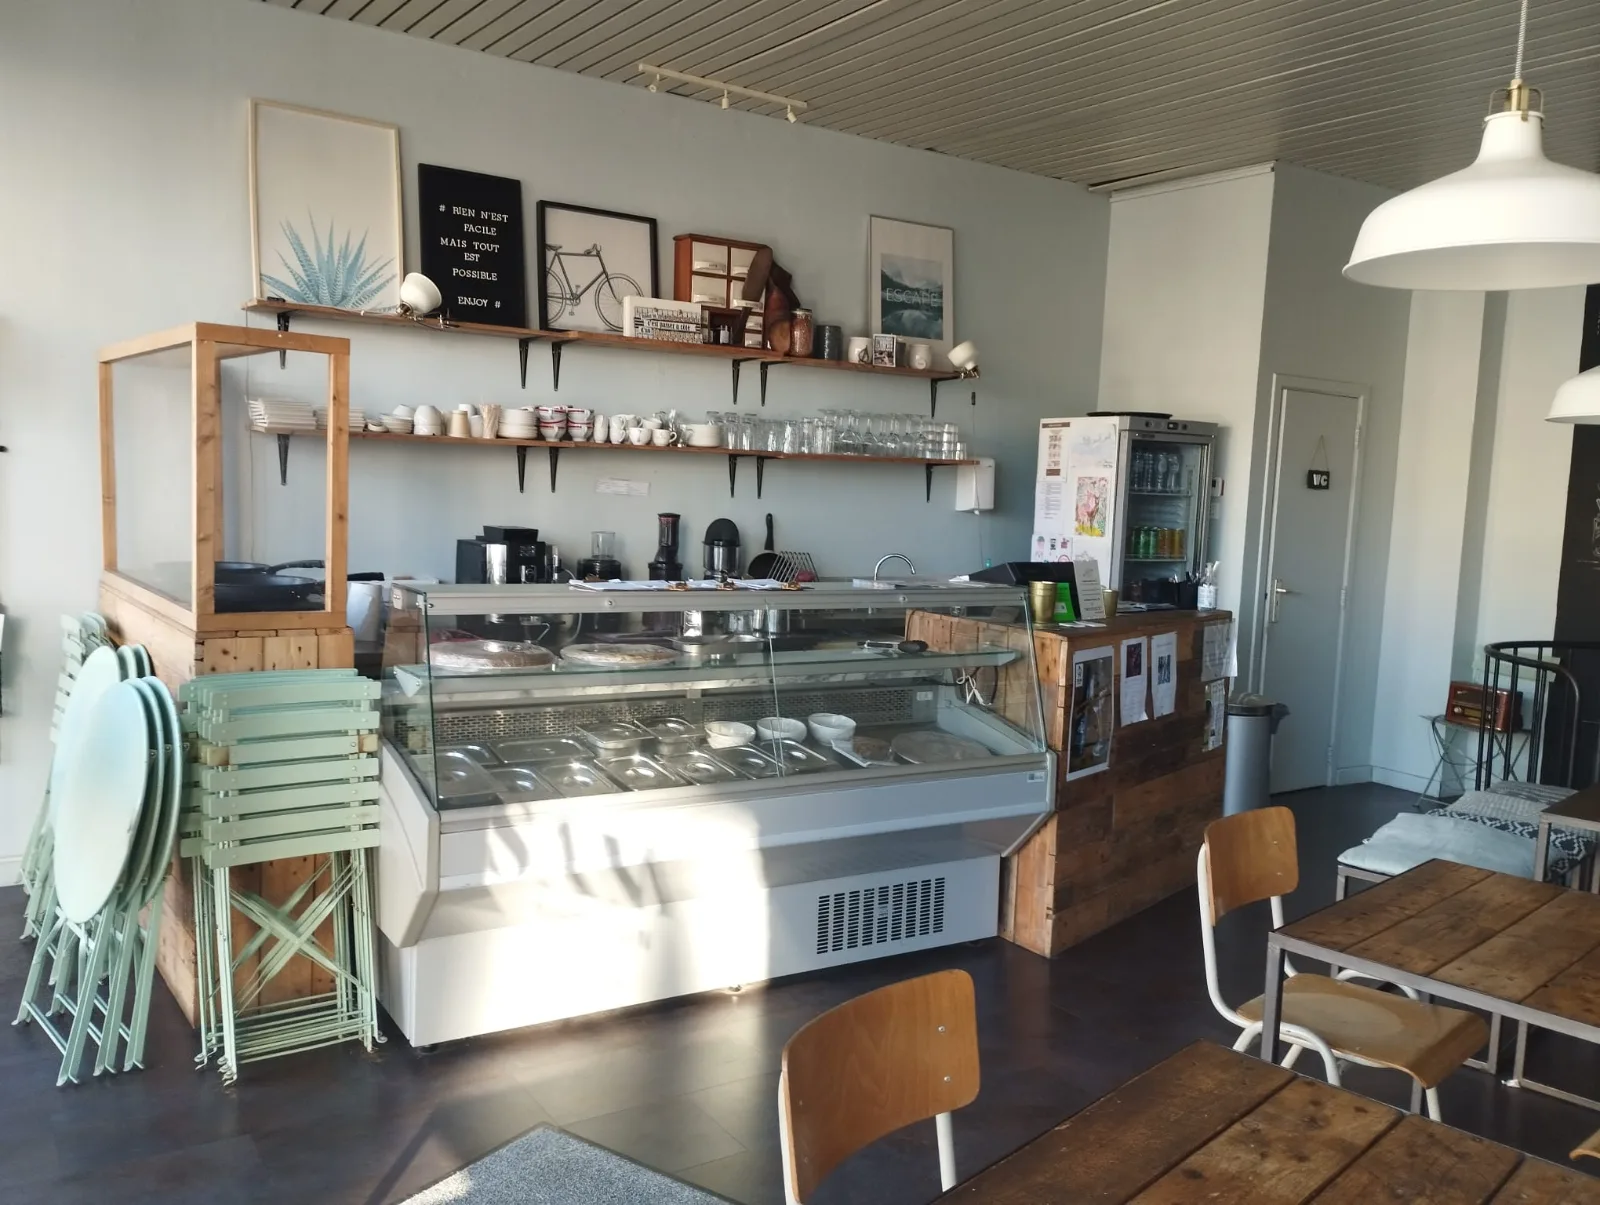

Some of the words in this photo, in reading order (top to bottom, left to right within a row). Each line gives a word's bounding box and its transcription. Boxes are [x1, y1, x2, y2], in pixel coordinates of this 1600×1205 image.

[452, 206, 475, 217] RIEN
[480, 210, 509, 223] N'EST
[463, 223, 497, 236] FACILE
[440, 236, 467, 248] MAIS
[472, 241, 500, 253] TOUT
[463, 252, 480, 262] EST
[452, 267, 498, 281] POSSIBLE
[457, 296, 488, 307] ENJOY
[886, 288, 939, 306] ESCAPE
[1312, 473, 1328, 486] WC
